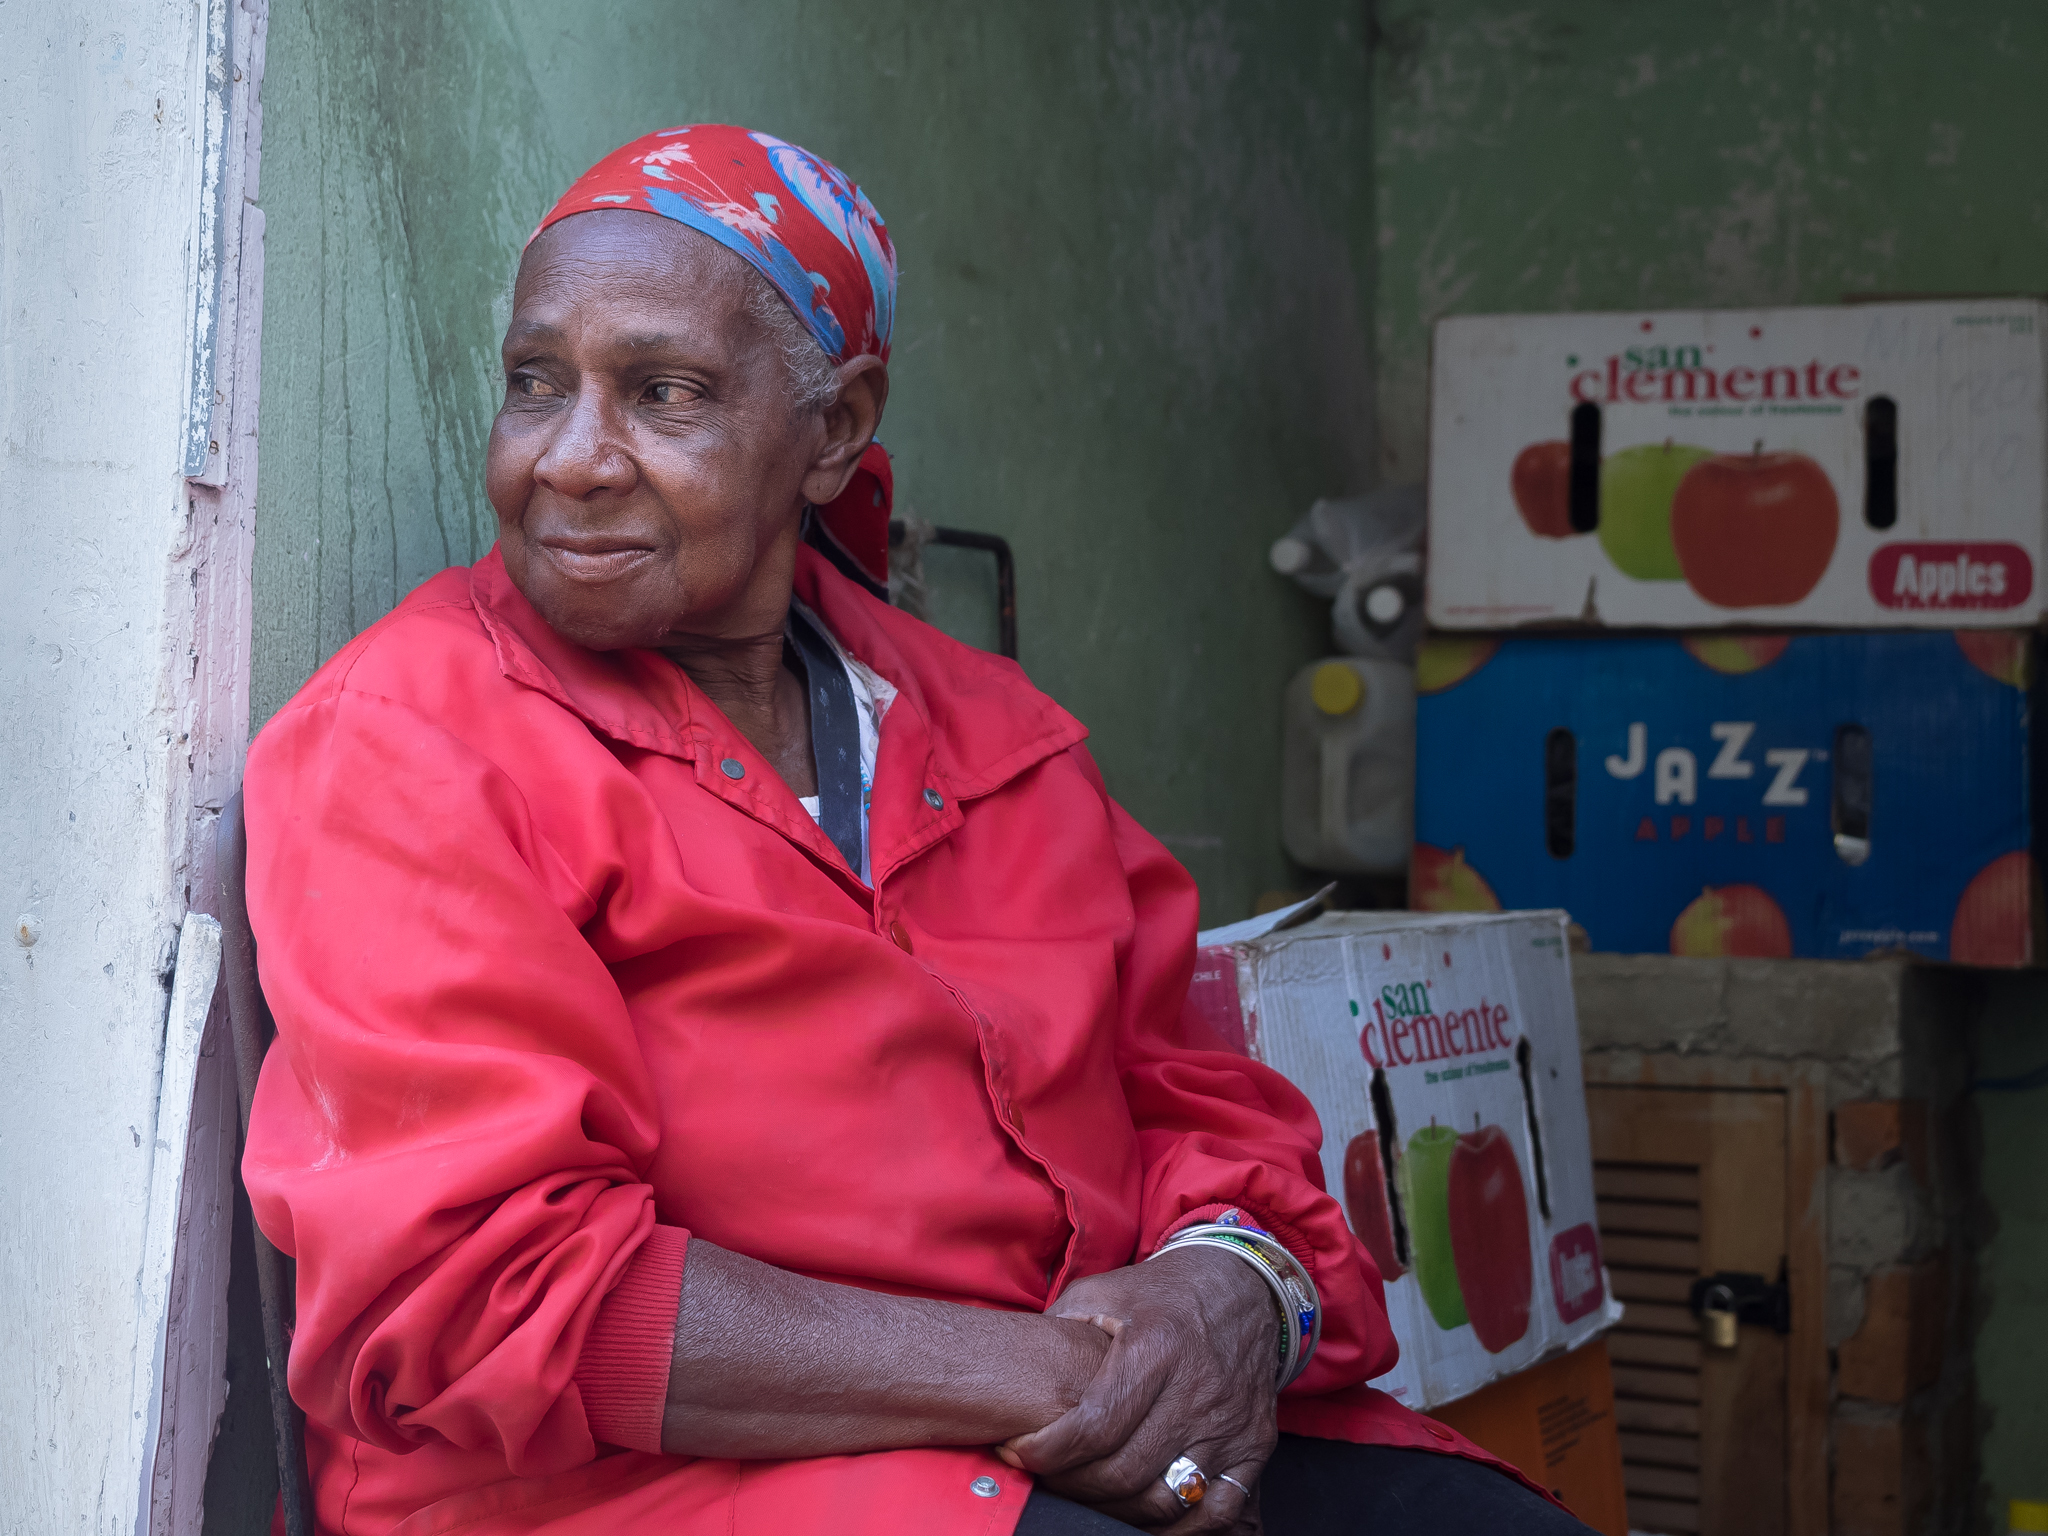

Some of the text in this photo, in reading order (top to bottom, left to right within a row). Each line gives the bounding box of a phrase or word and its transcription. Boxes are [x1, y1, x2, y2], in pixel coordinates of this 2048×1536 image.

[1569, 355, 1861, 404] clemente
[1623, 345, 1703, 371] san
[1893, 553, 2009, 603] Apples
[1604, 720, 1810, 806] JAZZ
[1635, 815, 1787, 843] APPLE
[1381, 981, 1432, 1020] san
[1359, 996, 1512, 1069] clemente
